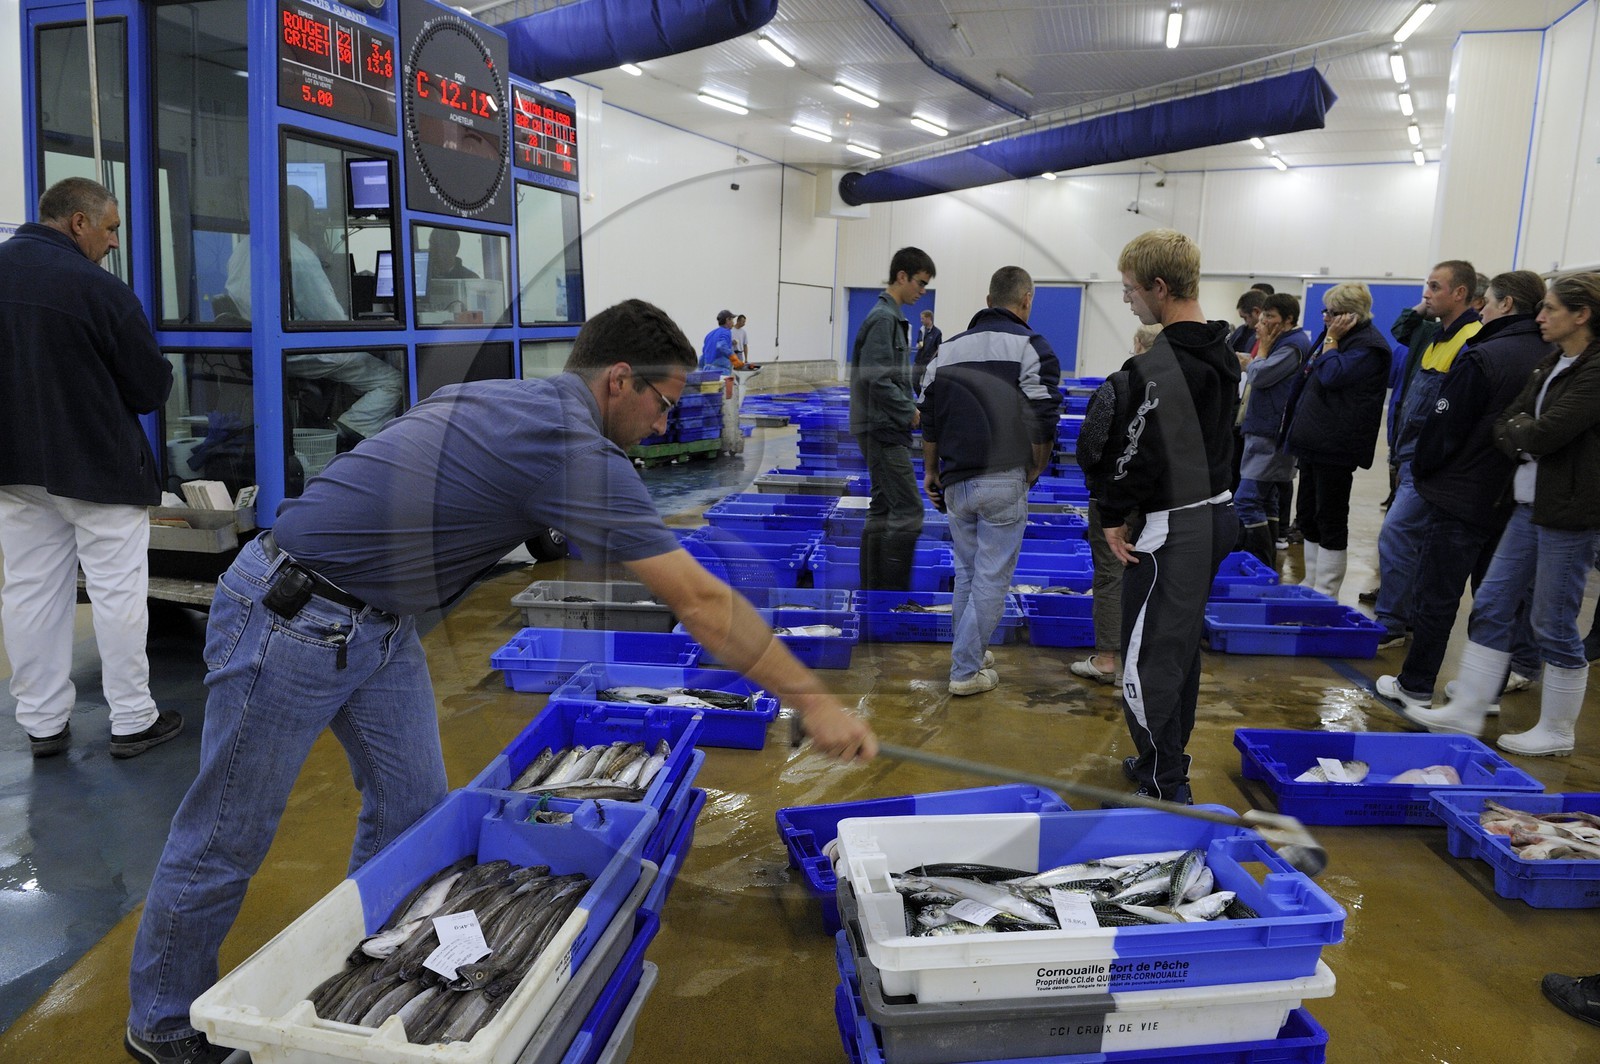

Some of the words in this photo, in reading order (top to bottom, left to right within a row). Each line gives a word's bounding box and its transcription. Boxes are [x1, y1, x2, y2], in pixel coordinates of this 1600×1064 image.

[283, 10, 329, 41] ROUGET
[284, 28, 330, 56] GRISET
[337, 31, 351, 49] 22
[372, 43, 392, 63] 3.4
[366, 56, 393, 78] 13.8
[416, 70, 429, 98] C
[454, 72, 466, 83] PRIX
[302, 84, 334, 108] 5.00
[449, 113, 474, 126] ACHETEUR
[1036, 964, 1105, 977] Cornouaille
[1109, 962, 1133, 973] Port
[1136, 961, 1150, 971] de
[1154, 960, 1190, 970] Pêche
[1035, 978, 1069, 987] Propriété
[1097, 970, 1188, 982] QUIMPER-CORNOUAILLE
[1050, 1027, 1070, 1036] CCI
[1077, 1025, 1112, 1035] CROIX
[1119, 1023, 1133, 1033] DE
[1141, 1021, 1159, 1031] VIE
